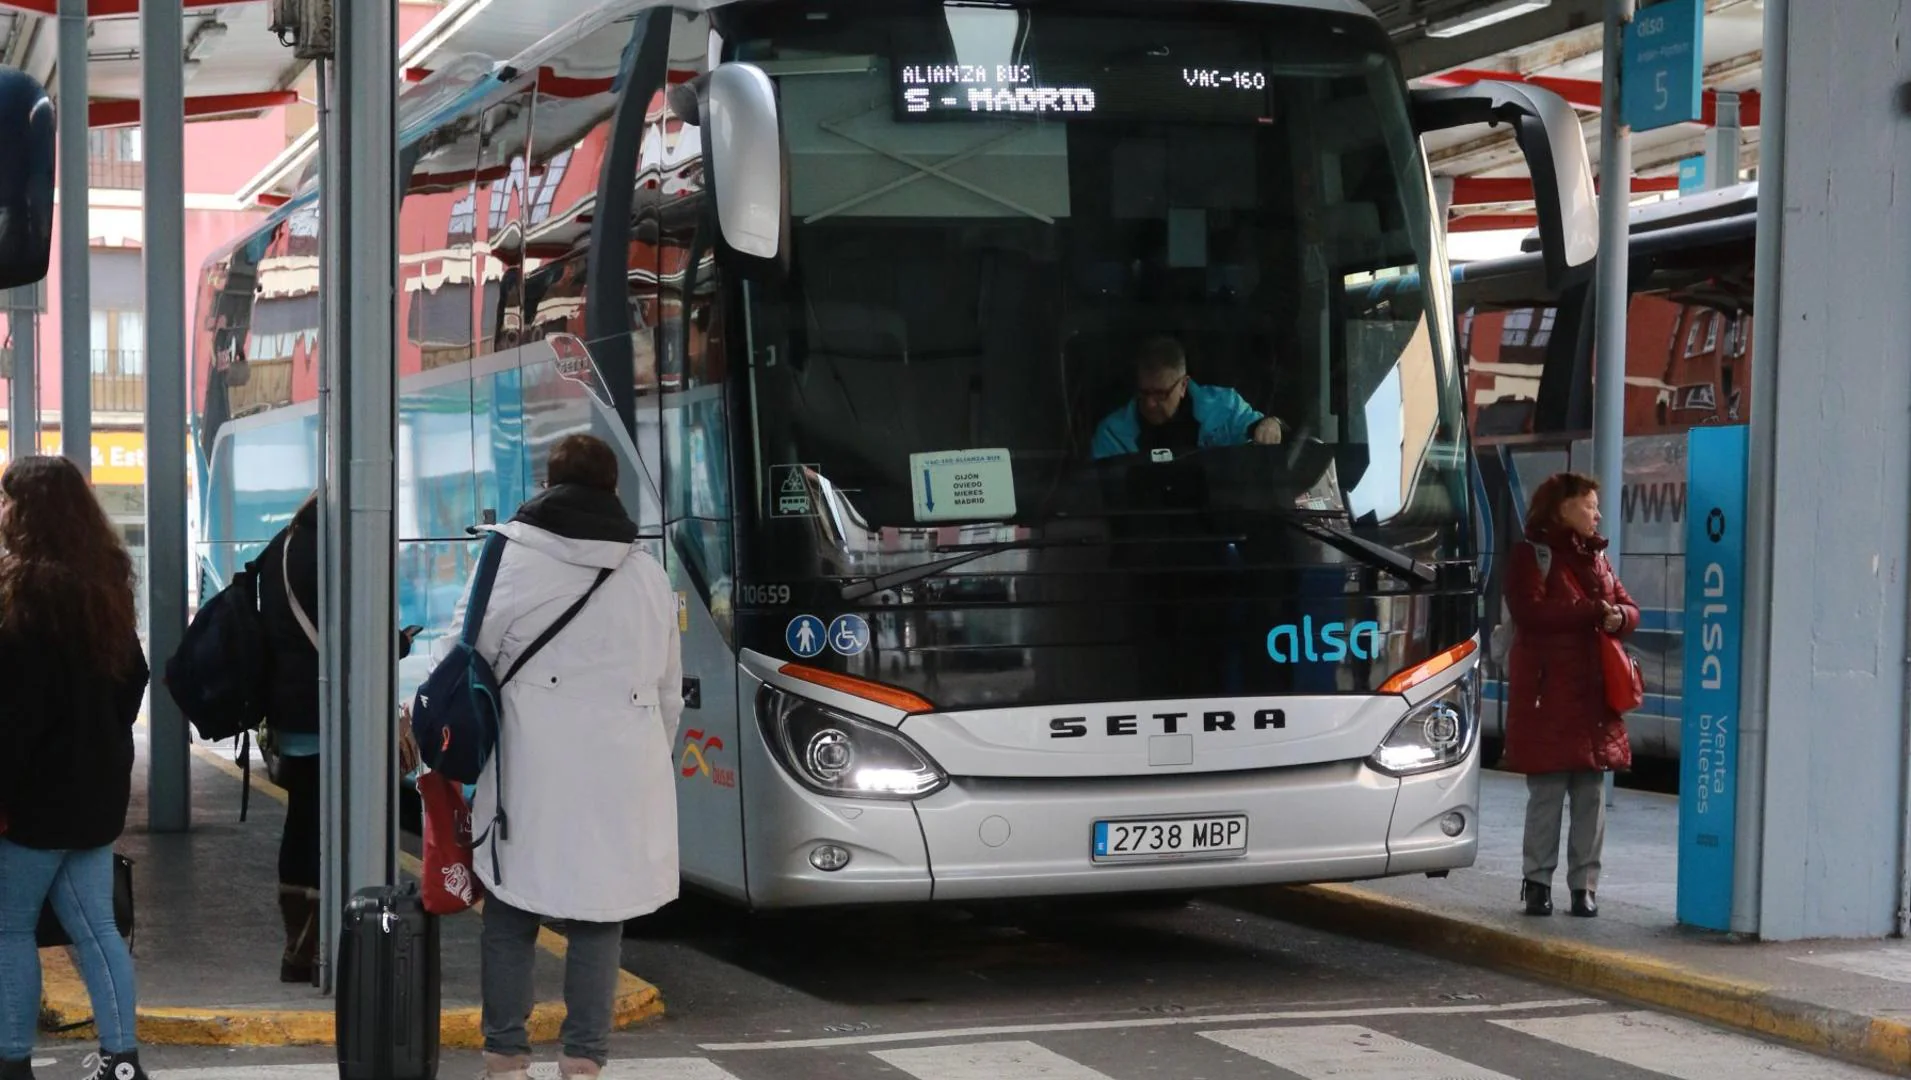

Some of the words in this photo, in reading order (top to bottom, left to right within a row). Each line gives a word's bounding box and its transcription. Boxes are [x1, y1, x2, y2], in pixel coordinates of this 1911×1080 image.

[903, 65, 986, 83] ALIANZA
[996, 65, 1031, 83] BUS
[1183, 68, 1265, 90] VAC-160
[967, 88, 1096, 112] MADRID
[1654, 70, 1668, 111] 5
[953, 481, 982, 489] OVIEDO
[955, 472, 979, 481] GIJÓN
[954, 489, 984, 497] MIERES
[954, 497, 985, 505] MADRID
[742, 585, 791, 604] 10659
[1702, 562, 1727, 690] alsa
[1267, 614, 1379, 663] alsa
[1050, 709, 1286, 738] SETRA
[1698, 714, 1713, 815] billetes
[1714, 715, 1728, 794] Venta
[1114, 825, 1182, 851] 2738
[1193, 820, 1241, 848] MBP
